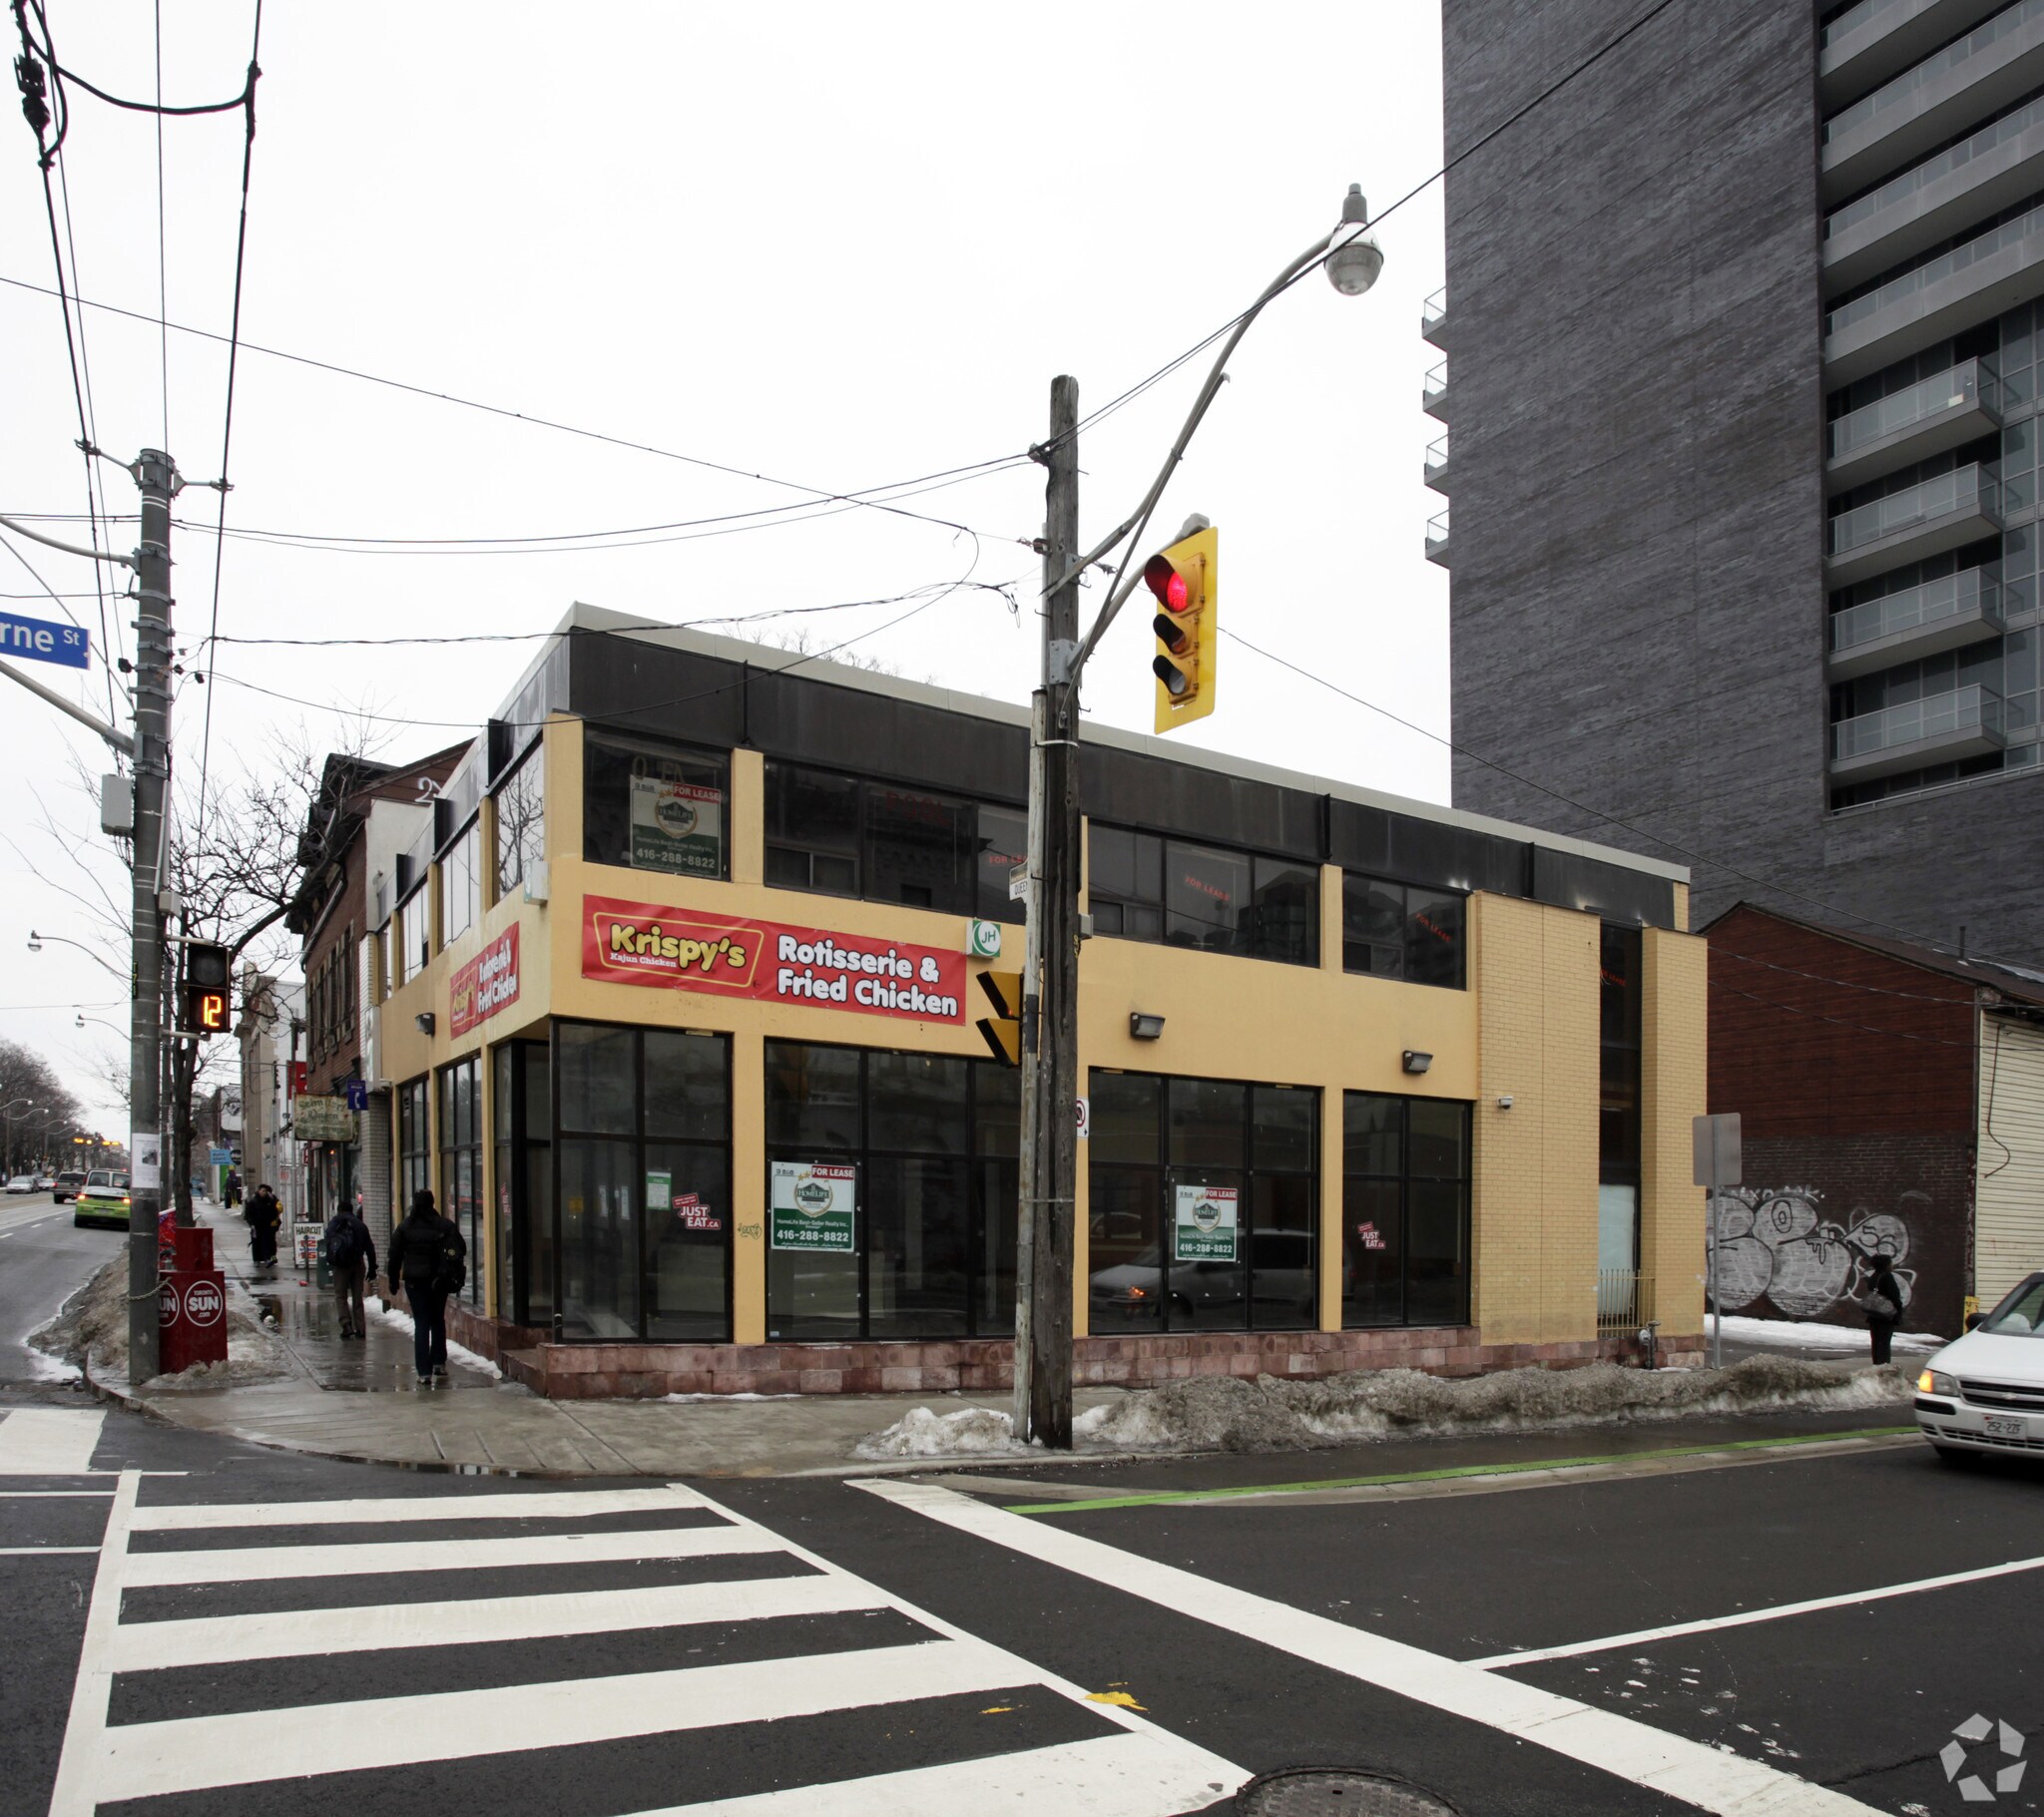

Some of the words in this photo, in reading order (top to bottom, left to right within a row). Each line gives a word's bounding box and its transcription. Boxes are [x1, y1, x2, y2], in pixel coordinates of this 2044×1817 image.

[63, 630, 80, 647] St
[674, 785, 692, 796] FOR
[693, 788, 720, 800] LEASE
[636, 847, 716, 869] 416-288-8822
[989, 855, 1008, 864] FOR
[981, 930, 996, 944] JH
[611, 923, 747, 972] Krispy's
[610, 953, 638, 964] Kajun
[640, 957, 677, 968] Chicken
[777, 934, 913, 979] Rotisserie
[919, 956, 940, 983] &
[777, 968, 847, 1003] Fried
[854, 979, 958, 1017] Chicken
[203, 995, 223, 1027] 12
[812, 1166, 828, 1176] FOR
[829, 1168, 854, 1177] LEASE
[681, 1205, 709, 1217] JUST
[776, 1229, 849, 1242] 416-288-8822
[1180, 1243, 1233, 1253] 416-288-8822
[188, 1296, 220, 1312] SUN
